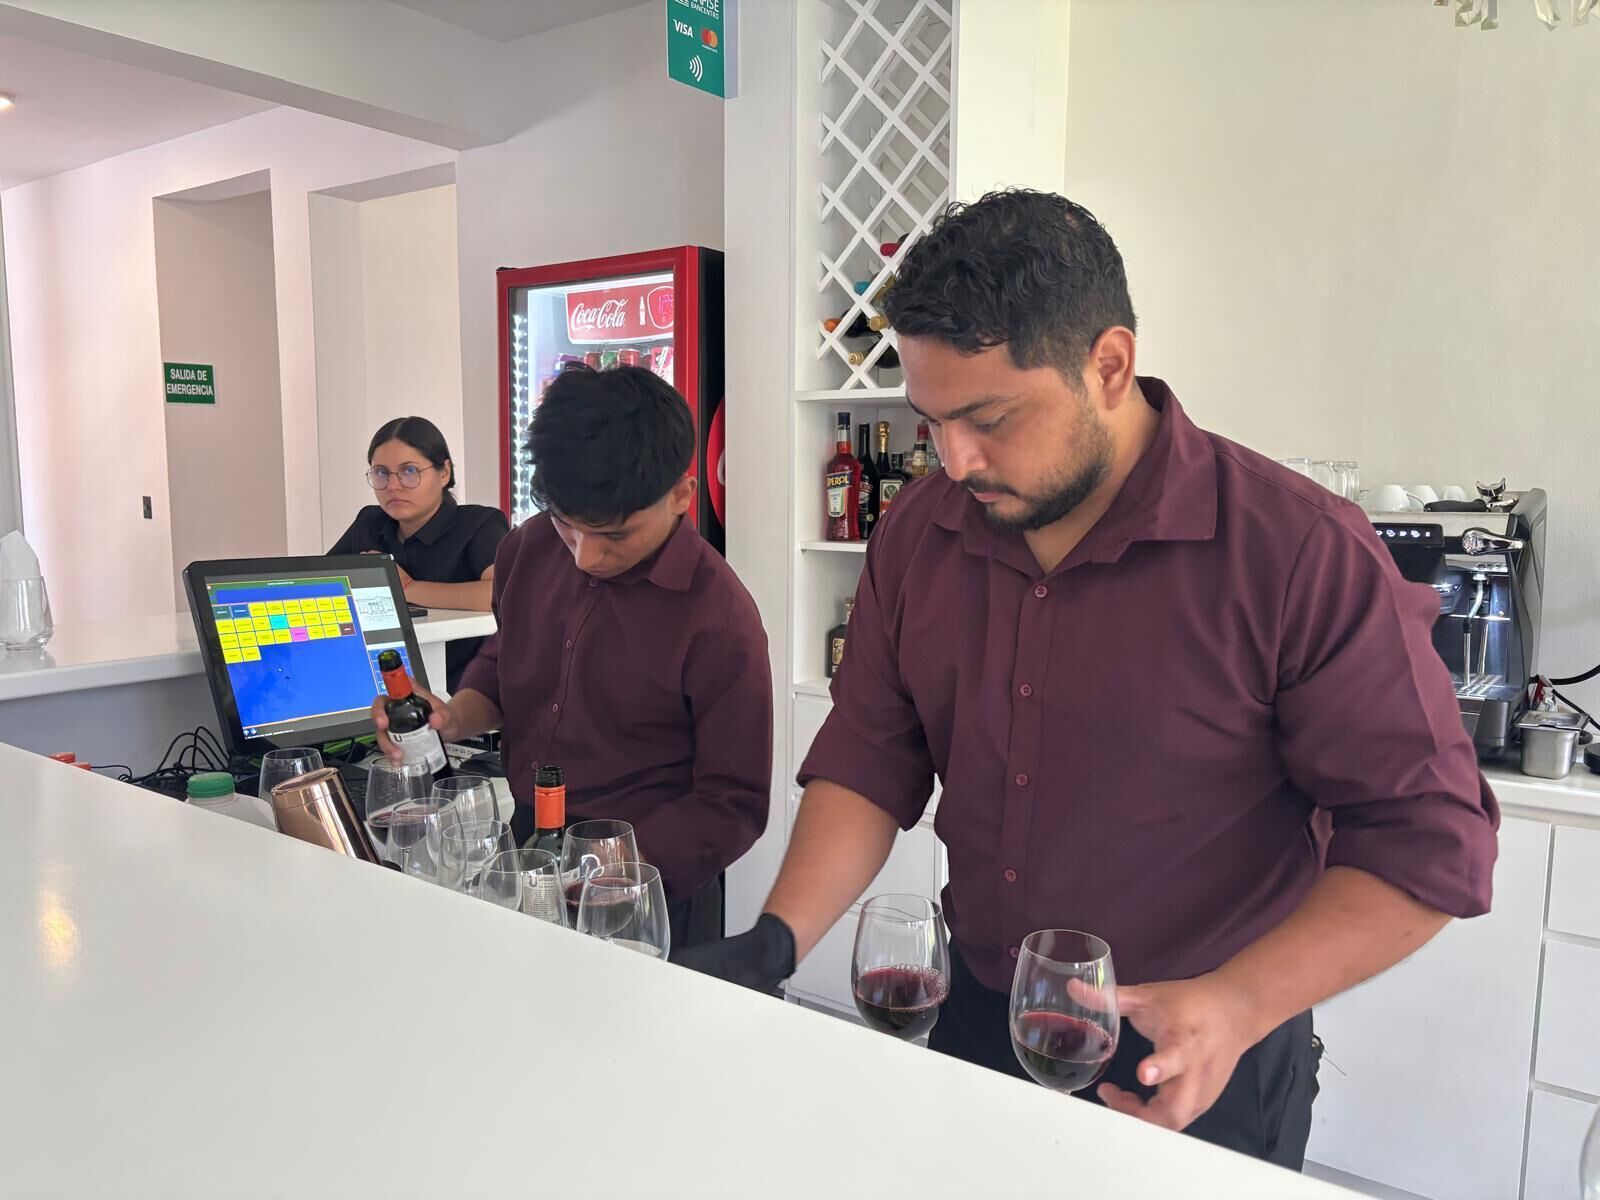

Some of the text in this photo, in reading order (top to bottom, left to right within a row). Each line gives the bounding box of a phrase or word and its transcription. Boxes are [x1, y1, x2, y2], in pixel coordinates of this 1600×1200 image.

[690, 1, 719, 19] BANCENTRO
[672, 18, 694, 38] VISA
[170, 368, 207, 381] SALIDA DE
[167, 384, 213, 395] EMERGENCIA
